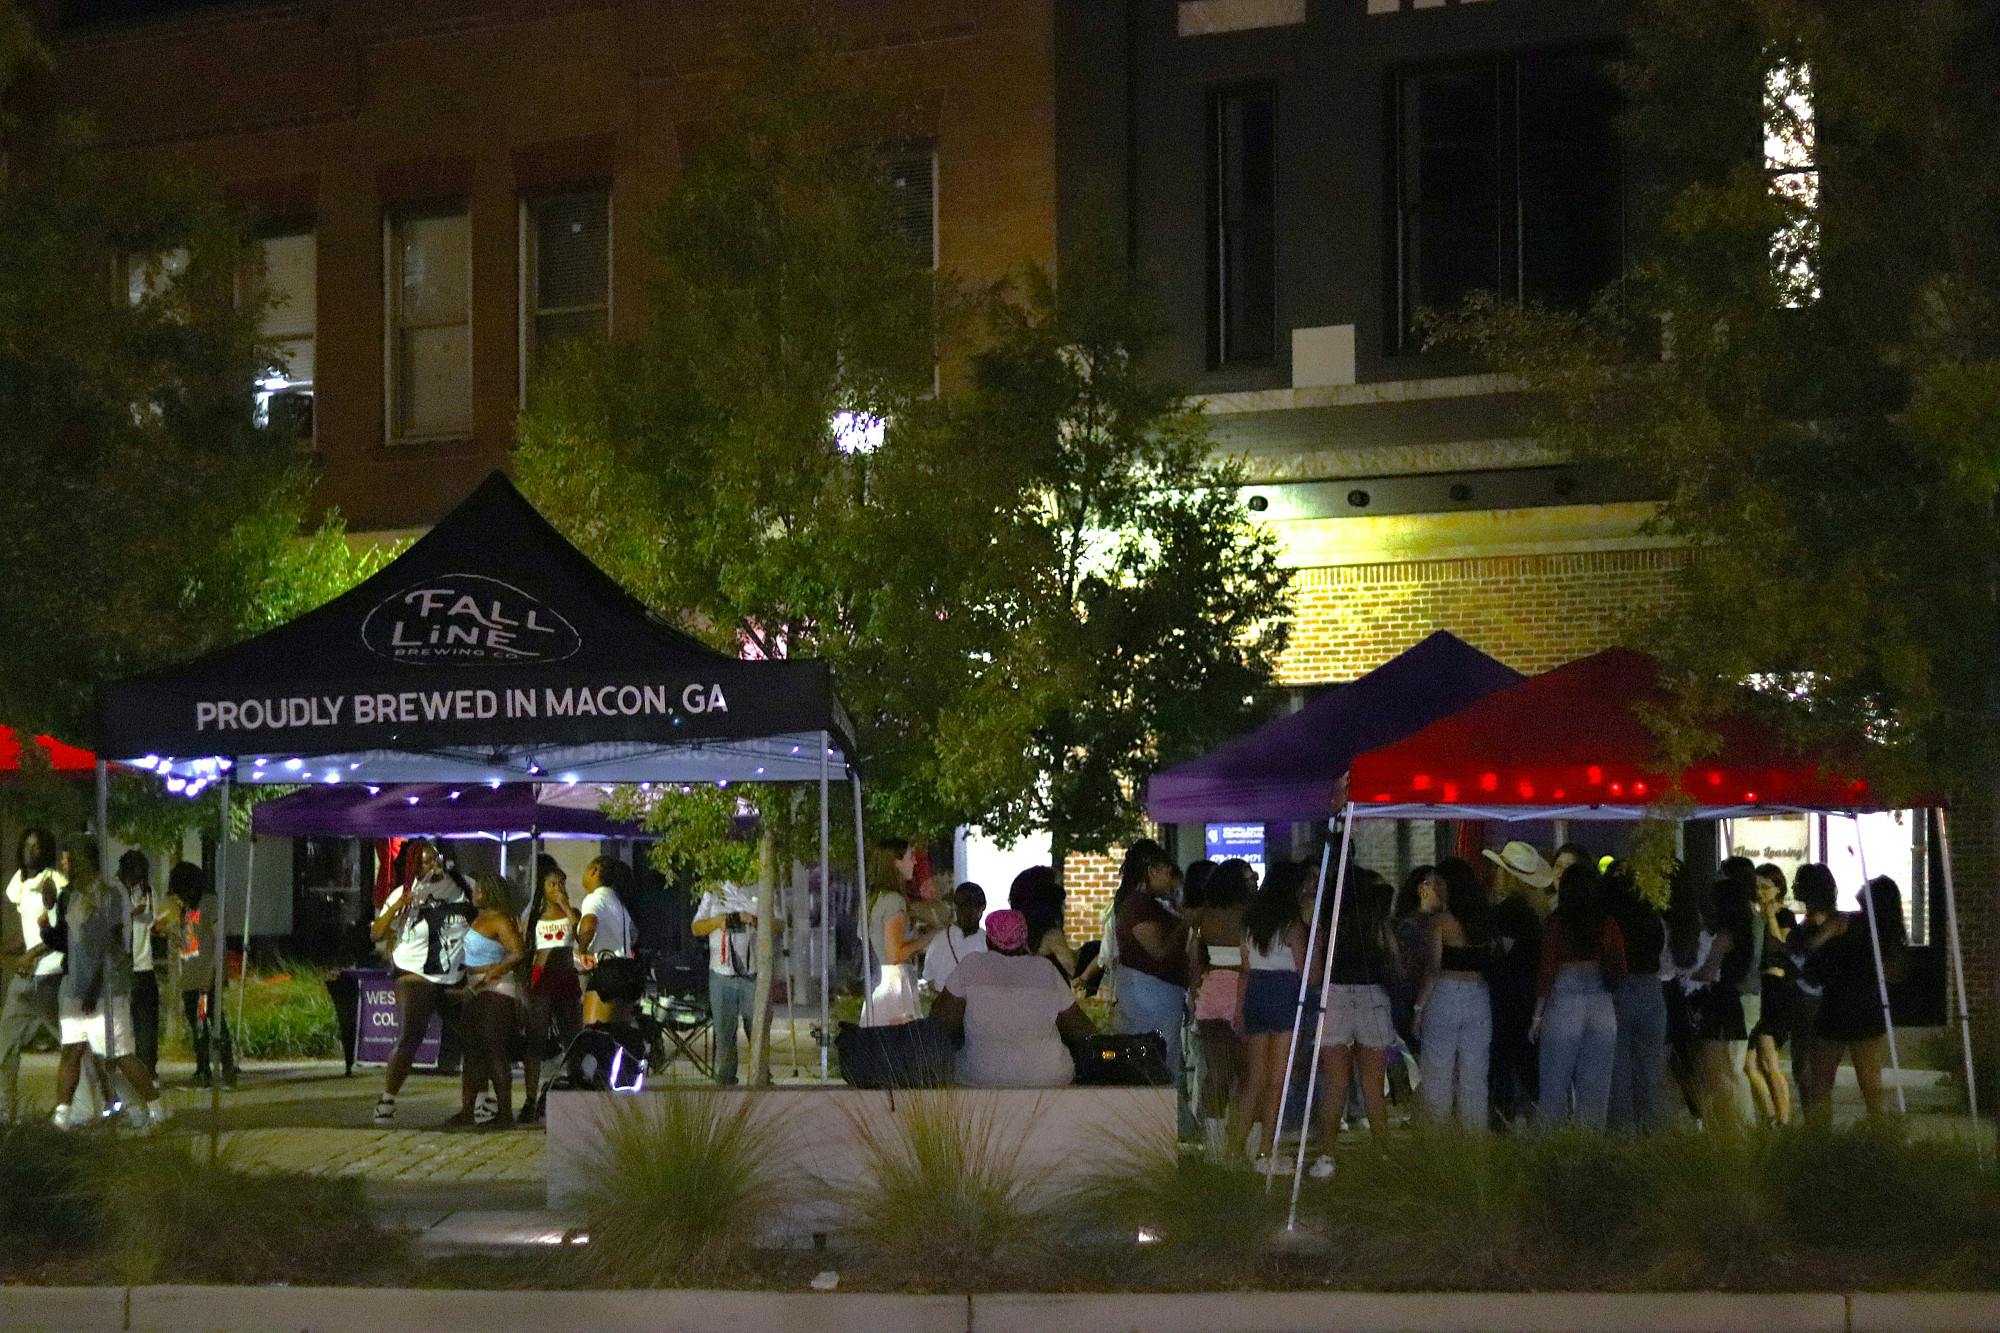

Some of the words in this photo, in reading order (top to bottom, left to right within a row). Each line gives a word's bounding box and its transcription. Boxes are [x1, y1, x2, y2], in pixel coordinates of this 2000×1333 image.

[404, 589, 555, 633] FALL
[395, 648, 485, 657] BREWING
[196, 695, 344, 731] PROUDLY
[353, 688, 498, 724] BREWED
[505, 688, 536, 718] IN
[682, 683, 728, 714] GA
[1734, 845, 1760, 857] Now
[366, 990, 397, 1006] WES
[372, 1011, 399, 1028] COL
